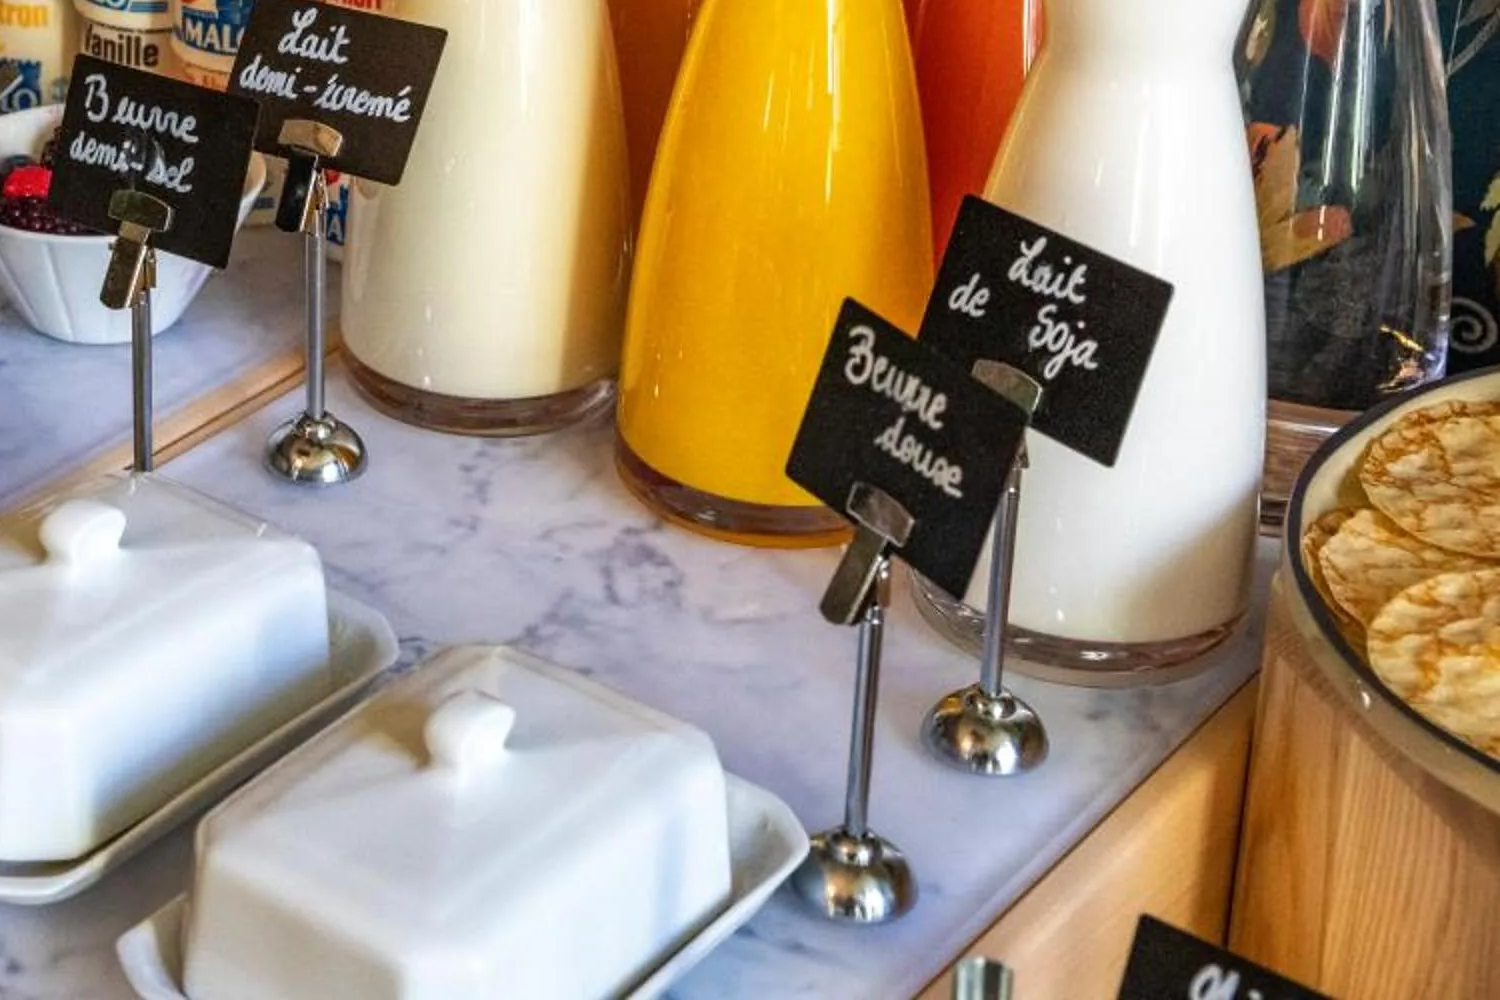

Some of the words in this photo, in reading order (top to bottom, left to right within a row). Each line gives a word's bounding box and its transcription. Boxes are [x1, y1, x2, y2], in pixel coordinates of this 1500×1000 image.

[278, 7, 351, 64] Lait
[84, 73, 200, 143] Beurre
[1008, 236, 1088, 305] Lait
[947, 272, 991, 318] de
[1027, 303, 1099, 381] Soja
[844, 325, 948, 430] Beurre
